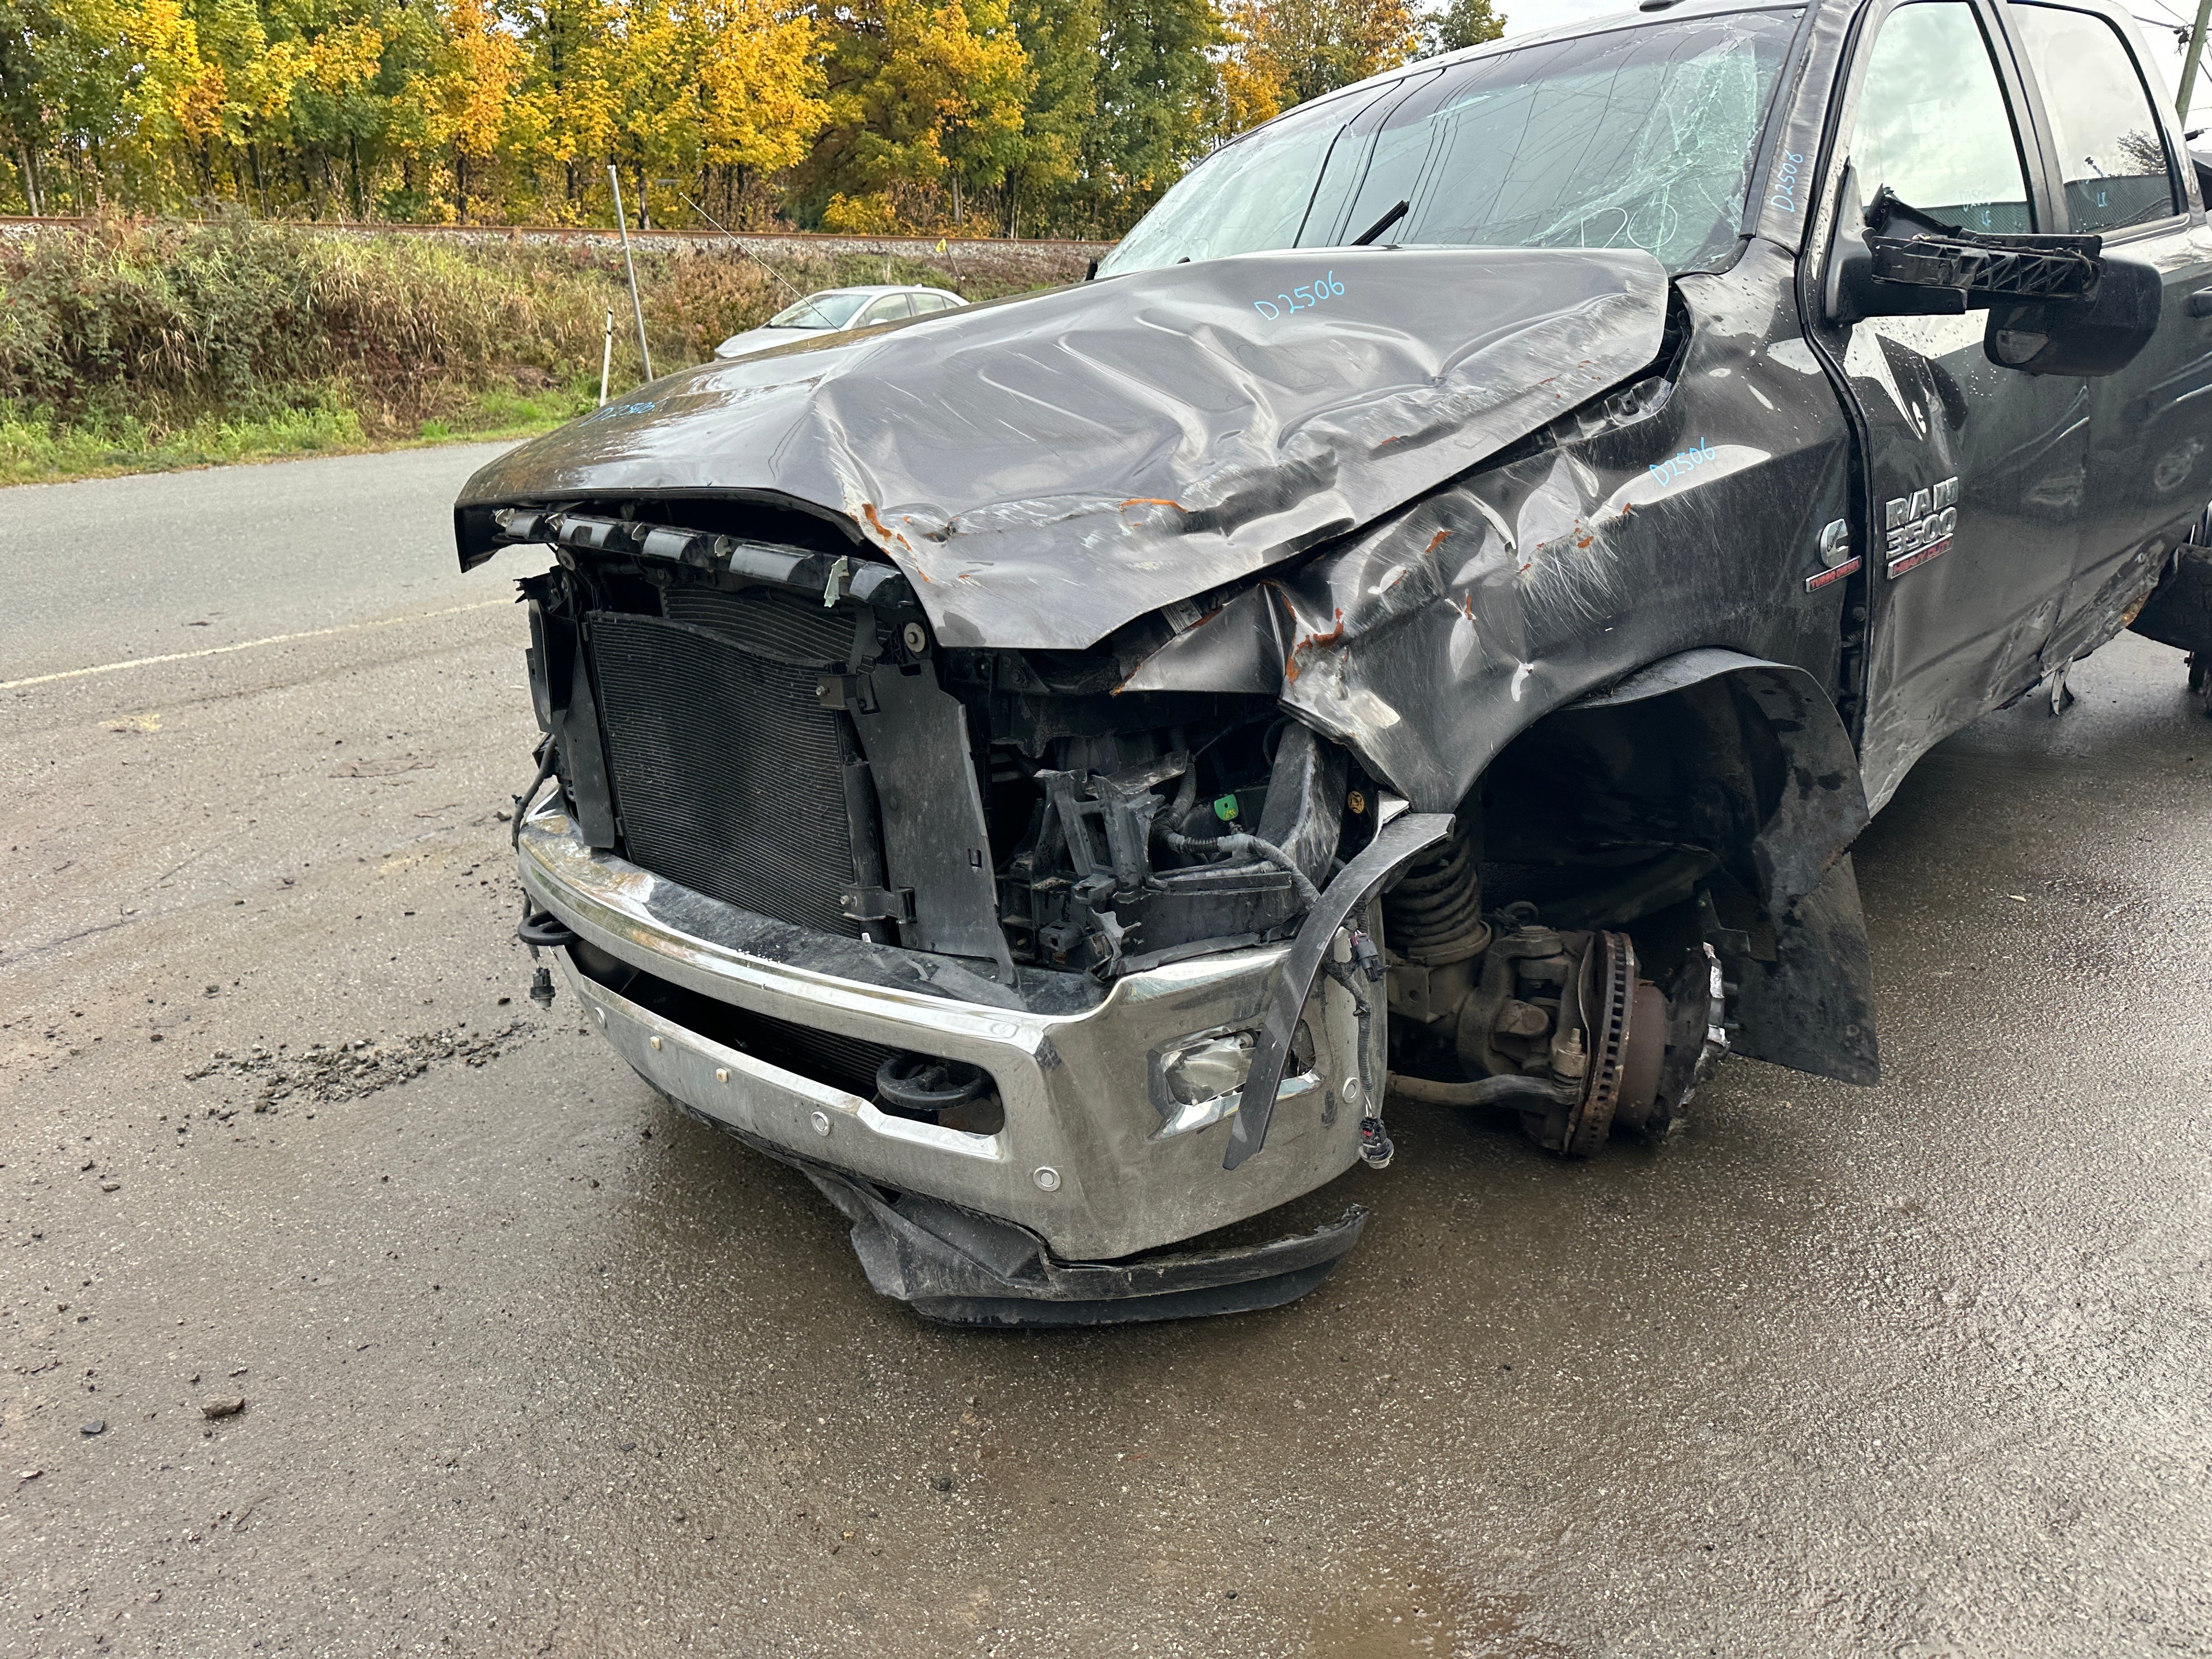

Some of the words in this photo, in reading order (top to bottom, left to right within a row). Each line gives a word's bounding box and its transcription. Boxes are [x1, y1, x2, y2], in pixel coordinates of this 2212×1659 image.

[1770, 149, 1804, 212] D2506
[1253, 270, 1345, 320] D2506
[1649, 437, 1716, 487] D2506
[1885, 476, 1959, 530] RAM
[1885, 506, 1957, 559] 3500
[1893, 550, 1927, 575] HEAVY
[1927, 537, 1952, 558] DUTY
